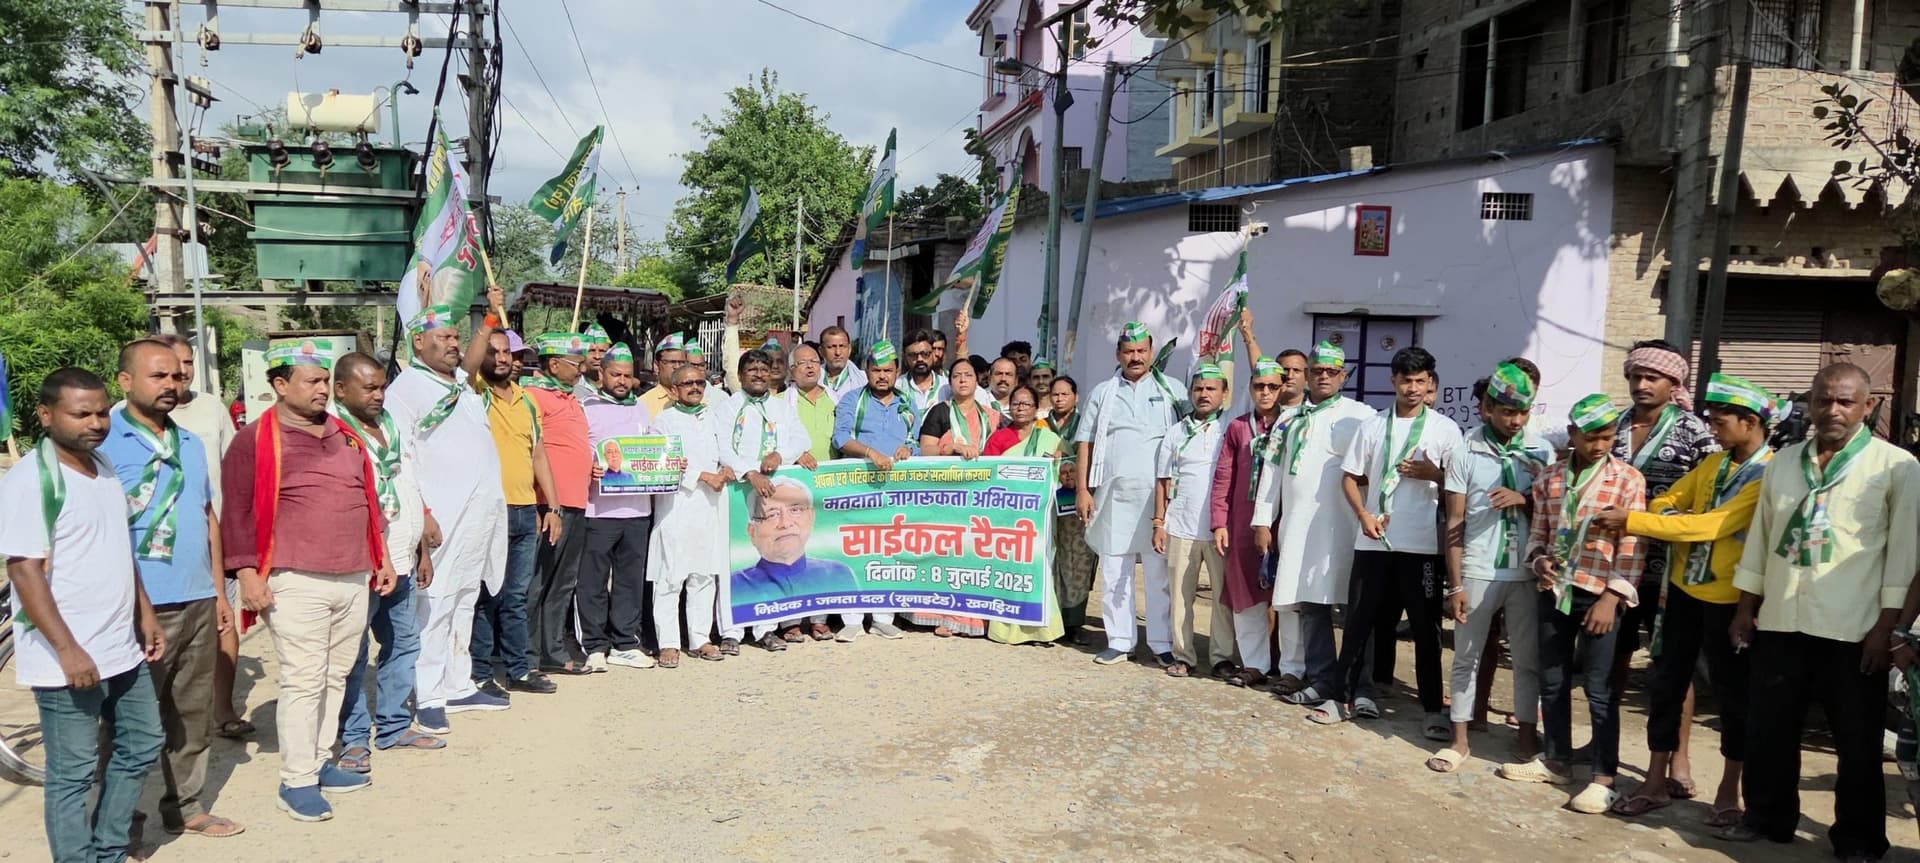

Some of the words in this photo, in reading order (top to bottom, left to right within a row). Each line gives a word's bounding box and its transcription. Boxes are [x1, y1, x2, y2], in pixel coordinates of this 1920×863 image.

[848, 467, 875, 484] परिवार
[889, 470, 907, 482] नाम
[929, 464, 964, 482] सत्यापित
[823, 491, 884, 510] मतदाता
[886, 490, 968, 506] जागरूकता
[972, 487, 1041, 511] अभियान
[839, 515, 966, 557] साईकल
[970, 516, 1037, 563] रैली
[865, 561, 916, 582] दिनांक
[930, 566, 942, 583] 8
[944, 565, 991, 590] जुलाई
[994, 571, 1033, 593] 2025
[753, 600, 803, 616] निवेदक
[815, 594, 857, 605] जनता
[861, 594, 885, 604] दल
[966, 598, 1021, 615] खगड़िया
